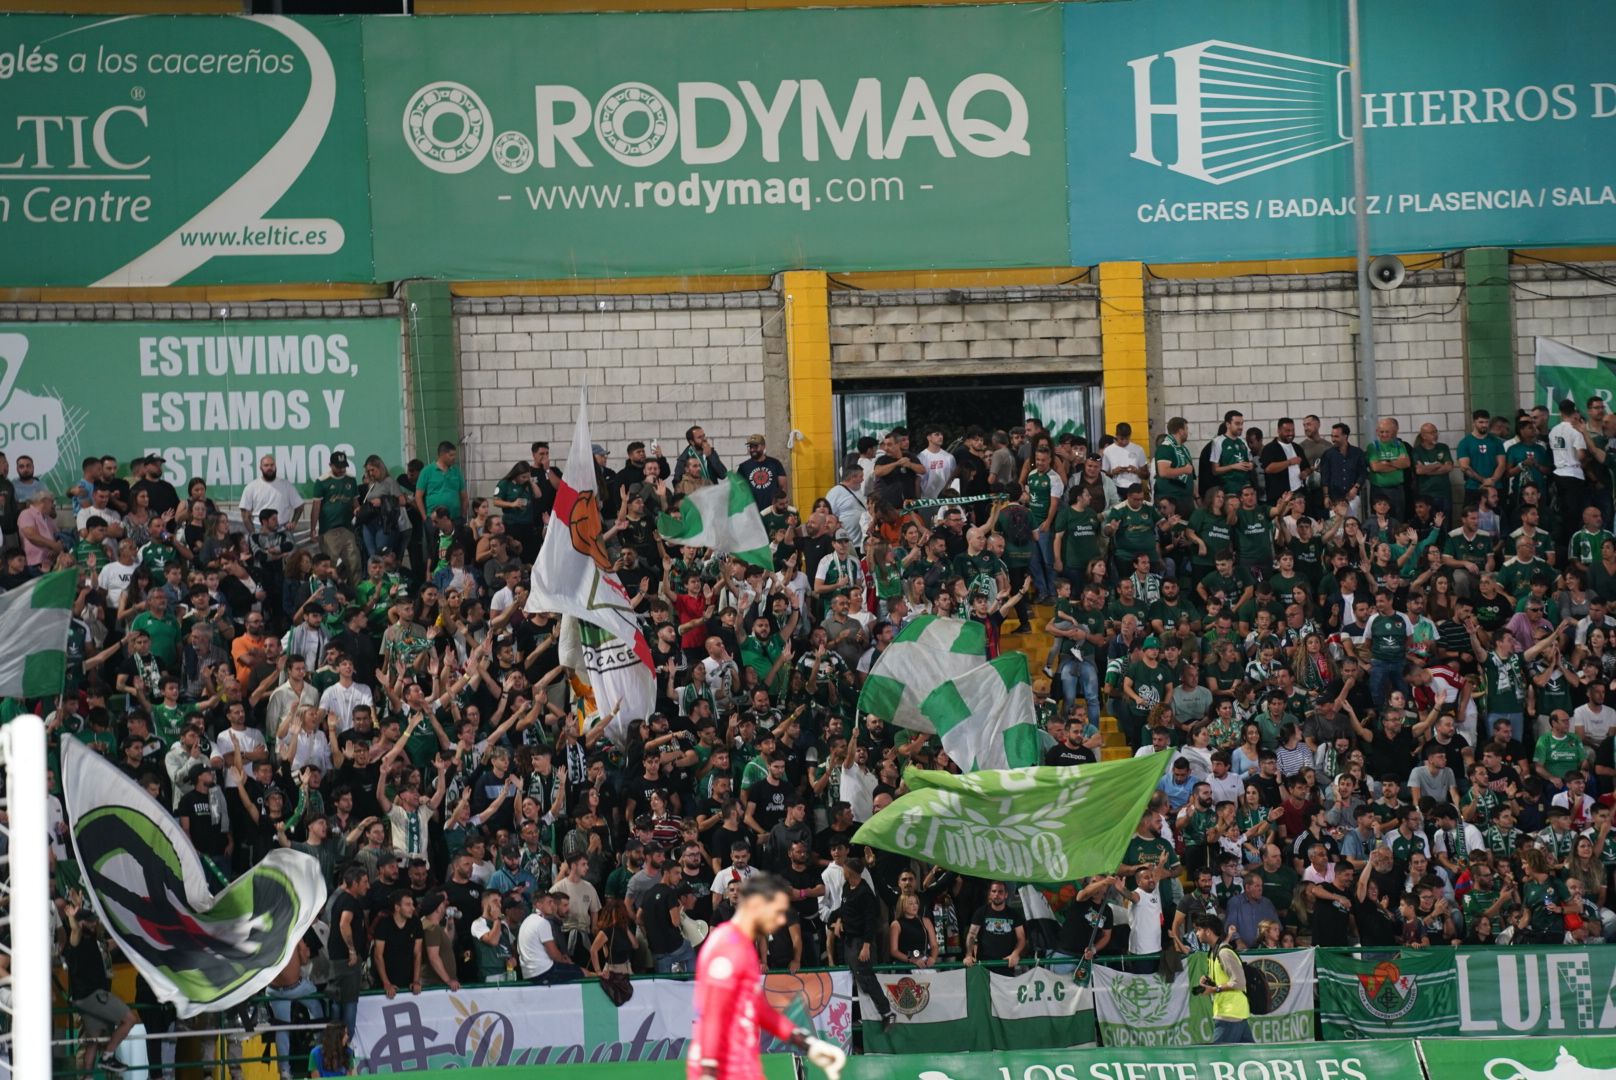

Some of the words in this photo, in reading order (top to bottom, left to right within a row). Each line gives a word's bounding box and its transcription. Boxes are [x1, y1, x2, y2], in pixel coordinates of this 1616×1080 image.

[68, 54, 86, 72] a
[97, 46, 138, 73] los
[148, 49, 294, 74] cacereños
[534, 72, 1031, 168] RODYMAQ
[1361, 83, 1578, 129] HIERROS
[23, 186, 152, 222] Centre
[526, 173, 905, 213] www.rodymaq.com
[1136, 198, 1250, 224] CÁCERES
[1399, 188, 1533, 214] PLASENCIA
[1552, 184, 1616, 207] SALA
[180, 227, 327, 247] www.keltic.es
[139, 333, 358, 378] ESTUVIMOS,
[142, 389, 311, 432] ESTAMOS
[322, 389, 345, 428] Y
[1455, 952, 1616, 1032] LUN
[1103, 1021, 1192, 1048] SUPPORTERS
